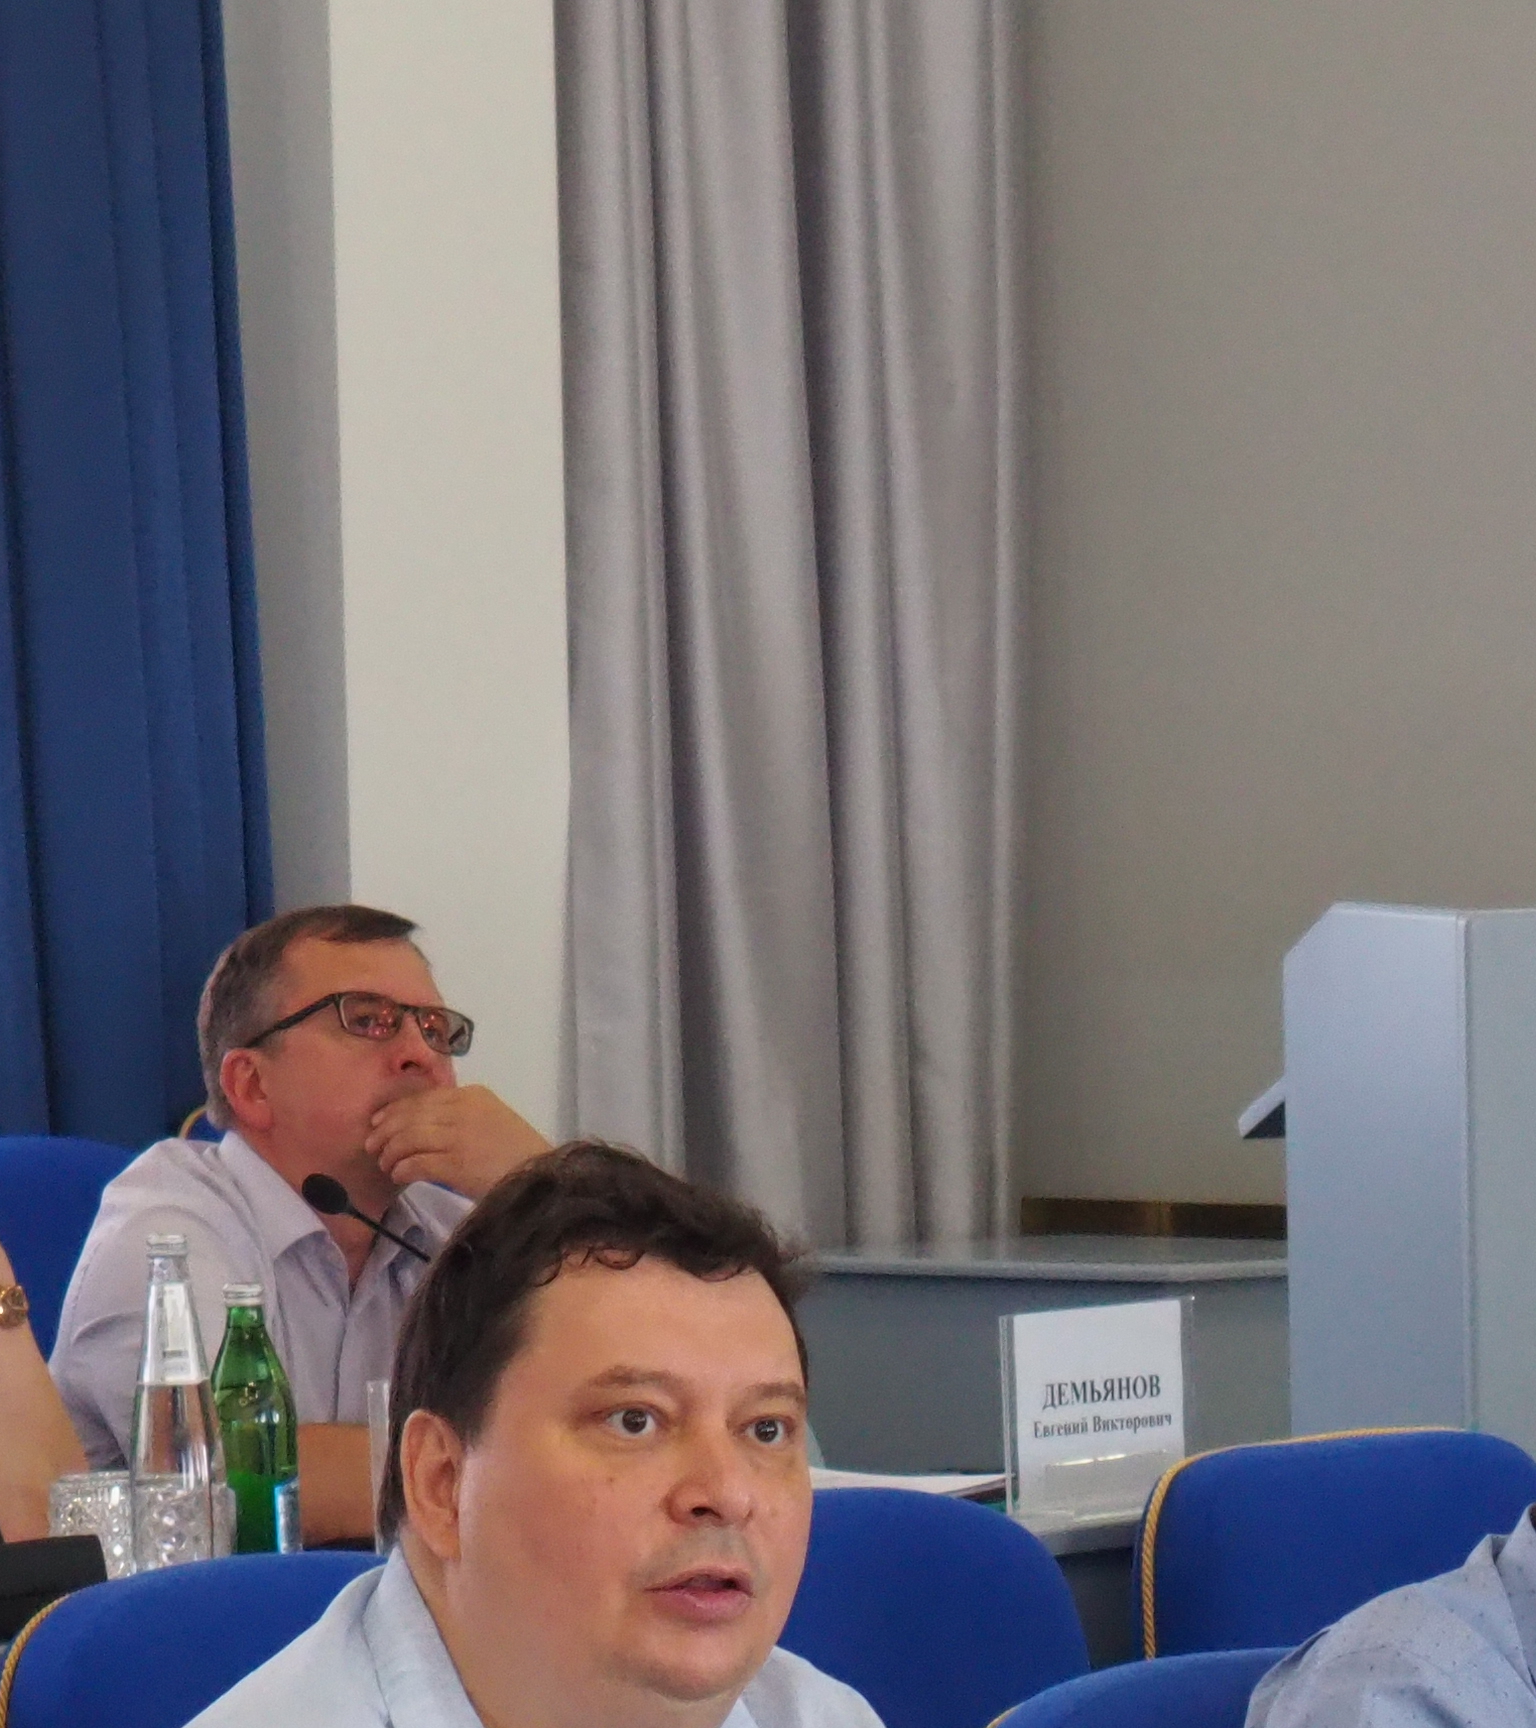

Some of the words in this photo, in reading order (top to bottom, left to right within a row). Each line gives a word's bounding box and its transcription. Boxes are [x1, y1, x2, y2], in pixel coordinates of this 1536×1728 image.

[1042, 1374, 1161, 1410] ДЕМЬЯНОВ
[1033, 1417, 1088, 1439] Евгений
[1092, 1413, 1172, 1434] Викторович
